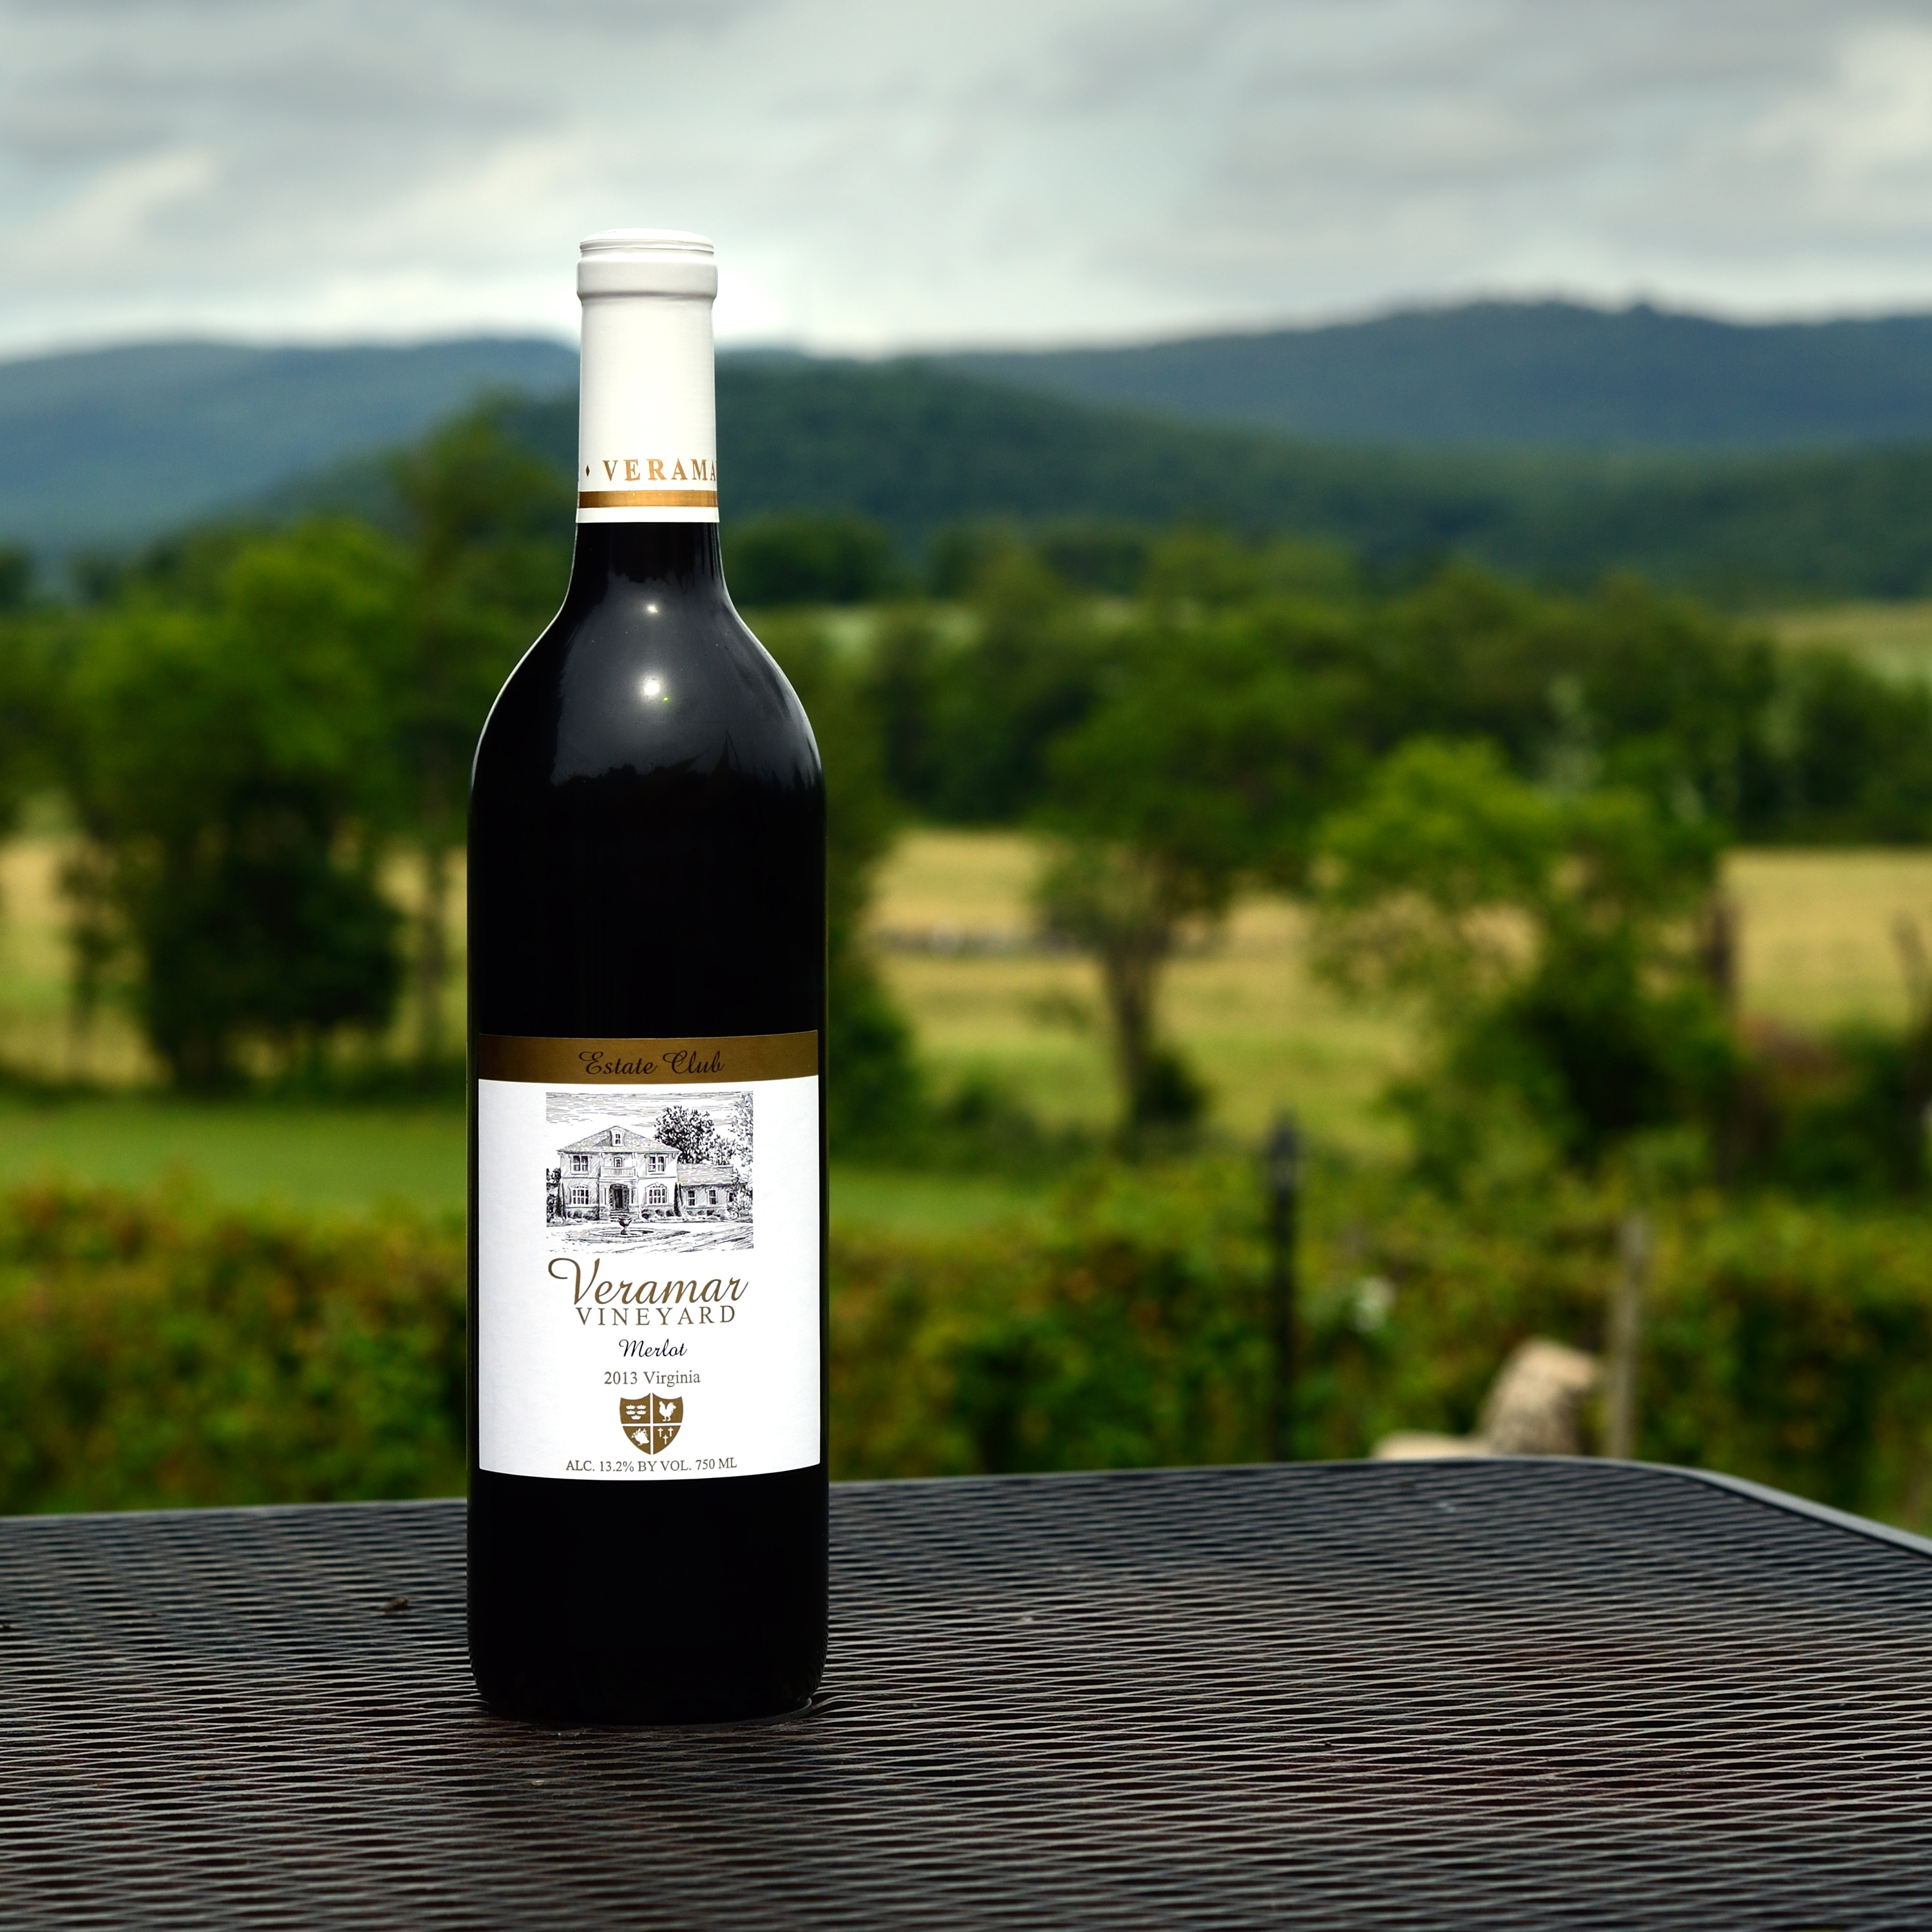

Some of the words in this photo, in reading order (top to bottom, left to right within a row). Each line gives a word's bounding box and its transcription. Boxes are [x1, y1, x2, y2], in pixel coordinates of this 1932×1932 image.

[602, 458, 716, 482] VERAMA
[579, 1050, 658, 1075] Estate
[663, 1050, 725, 1074] Club
[548, 1257, 749, 1305] Veramar
[575, 1305, 735, 1326] VINEYARD
[618, 1338, 688, 1358] Merlot
[603, 1371, 638, 1385] 2013
[643, 1370, 701, 1387] Virginia
[565, 1460, 595, 1472] ALC.
[600, 1461, 634, 1472] 13.2%
[638, 1461, 657, 1472] BY
[660, 1460, 692, 1471] VOL.
[695, 1458, 715, 1470] 750
[719, 1457, 737, 1470] ML
